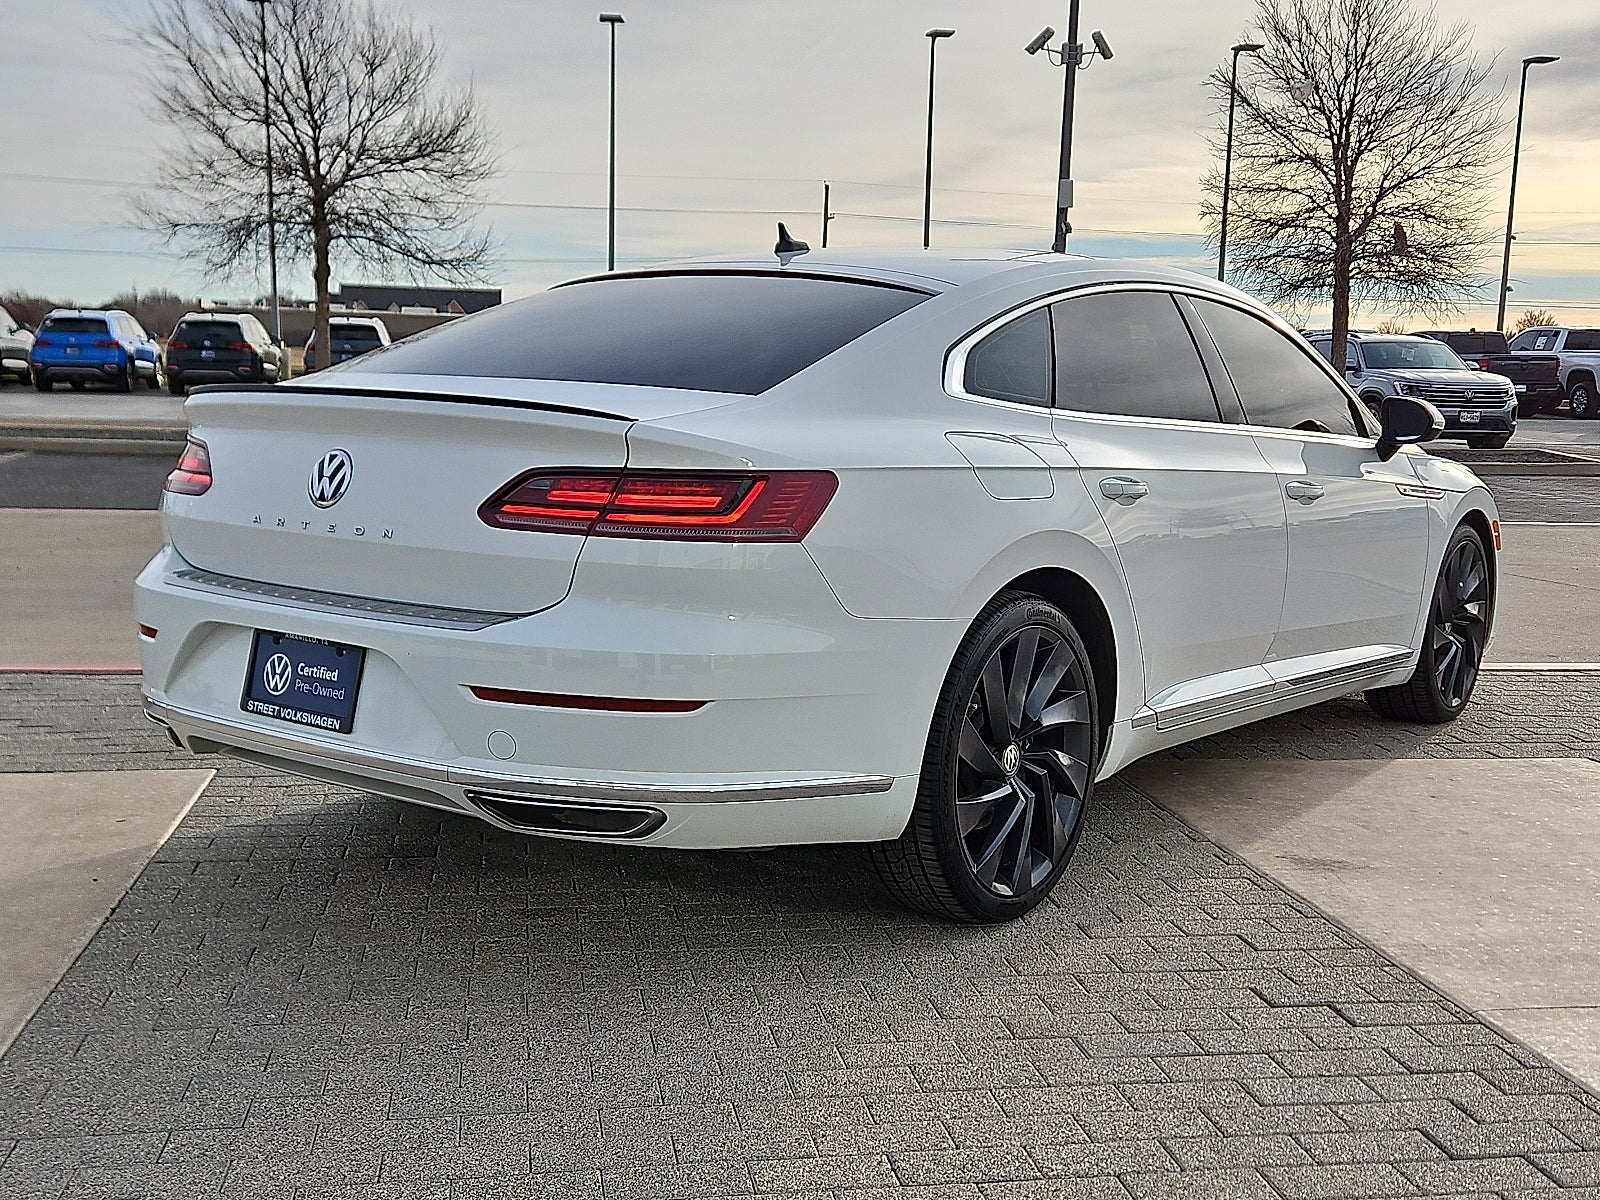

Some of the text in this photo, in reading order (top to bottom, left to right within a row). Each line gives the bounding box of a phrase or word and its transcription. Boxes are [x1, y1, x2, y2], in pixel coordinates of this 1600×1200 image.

[253, 514, 394, 539] ARTEON
[1026, 607, 1057, 622] Continental
[297, 663, 339, 682] Certified
[294, 679, 345, 700] Pre-Owned
[247, 700, 340, 730] STREET VOLKSWAGEN
